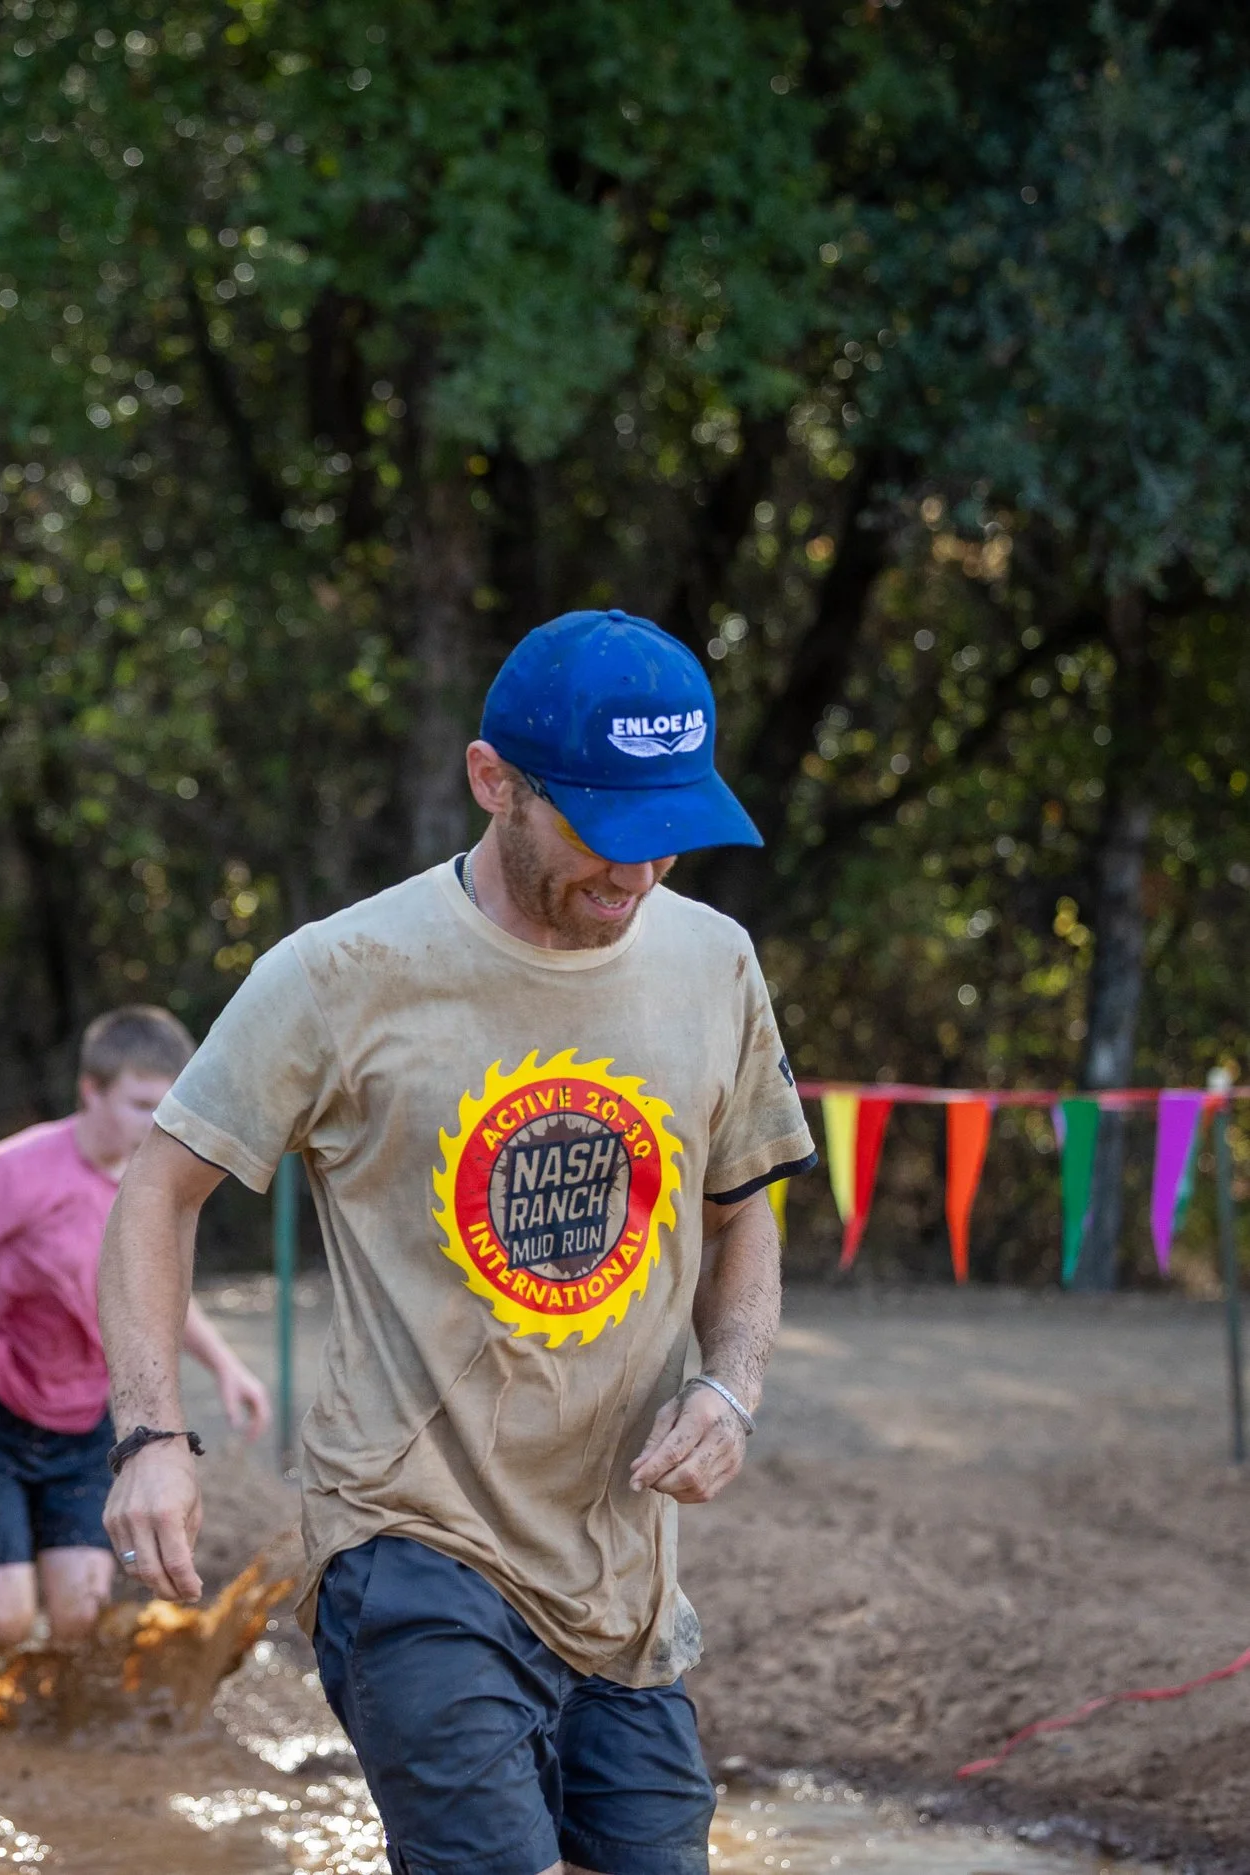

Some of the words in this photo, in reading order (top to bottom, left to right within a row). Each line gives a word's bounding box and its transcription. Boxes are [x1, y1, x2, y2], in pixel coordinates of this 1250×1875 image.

[611, 714, 683, 737] ENLOE
[481, 1087, 572, 1151] ACTIVE
[584, 1091, 653, 1159] 20-30
[512, 1137, 617, 1194] NASH
[508, 1182, 609, 1233] RANCH
[468, 1221, 644, 1308] INTERNATIONAL
[512, 1236, 554, 1266] MUD
[562, 1224, 603, 1255] RUN
